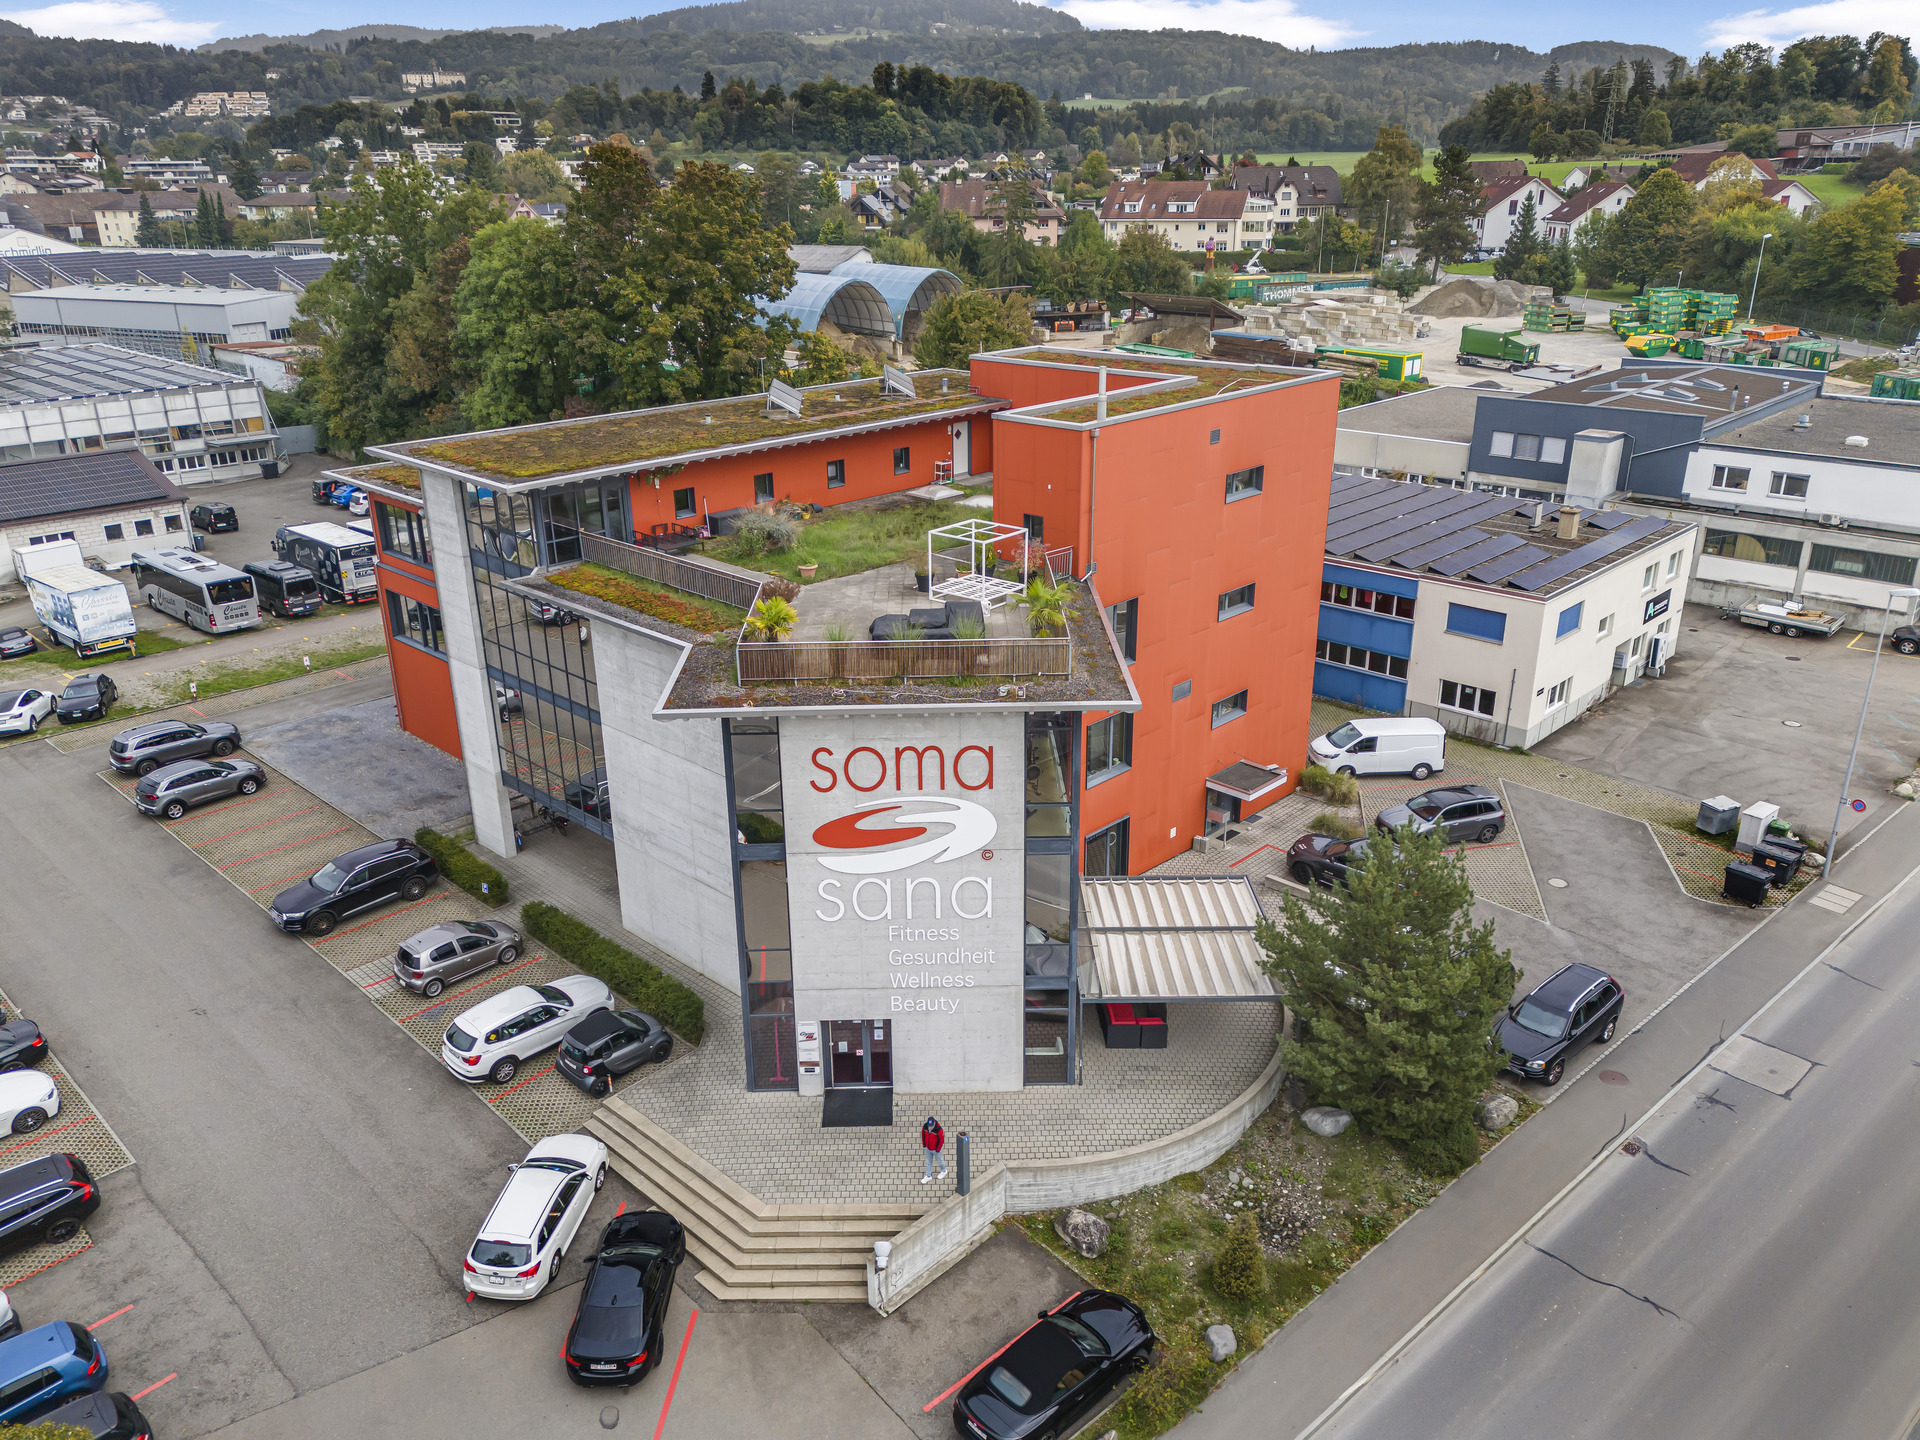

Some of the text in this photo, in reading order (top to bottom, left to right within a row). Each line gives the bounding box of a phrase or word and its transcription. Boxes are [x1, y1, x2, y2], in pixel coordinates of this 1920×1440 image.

[810, 745, 994, 793] soma
[815, 876, 994, 922] sana
[888, 925, 960, 942] Fitness
[889, 948, 996, 966] Gesundheit
[890, 971, 975, 989] Wellness
[891, 995, 960, 1014] Beauty
